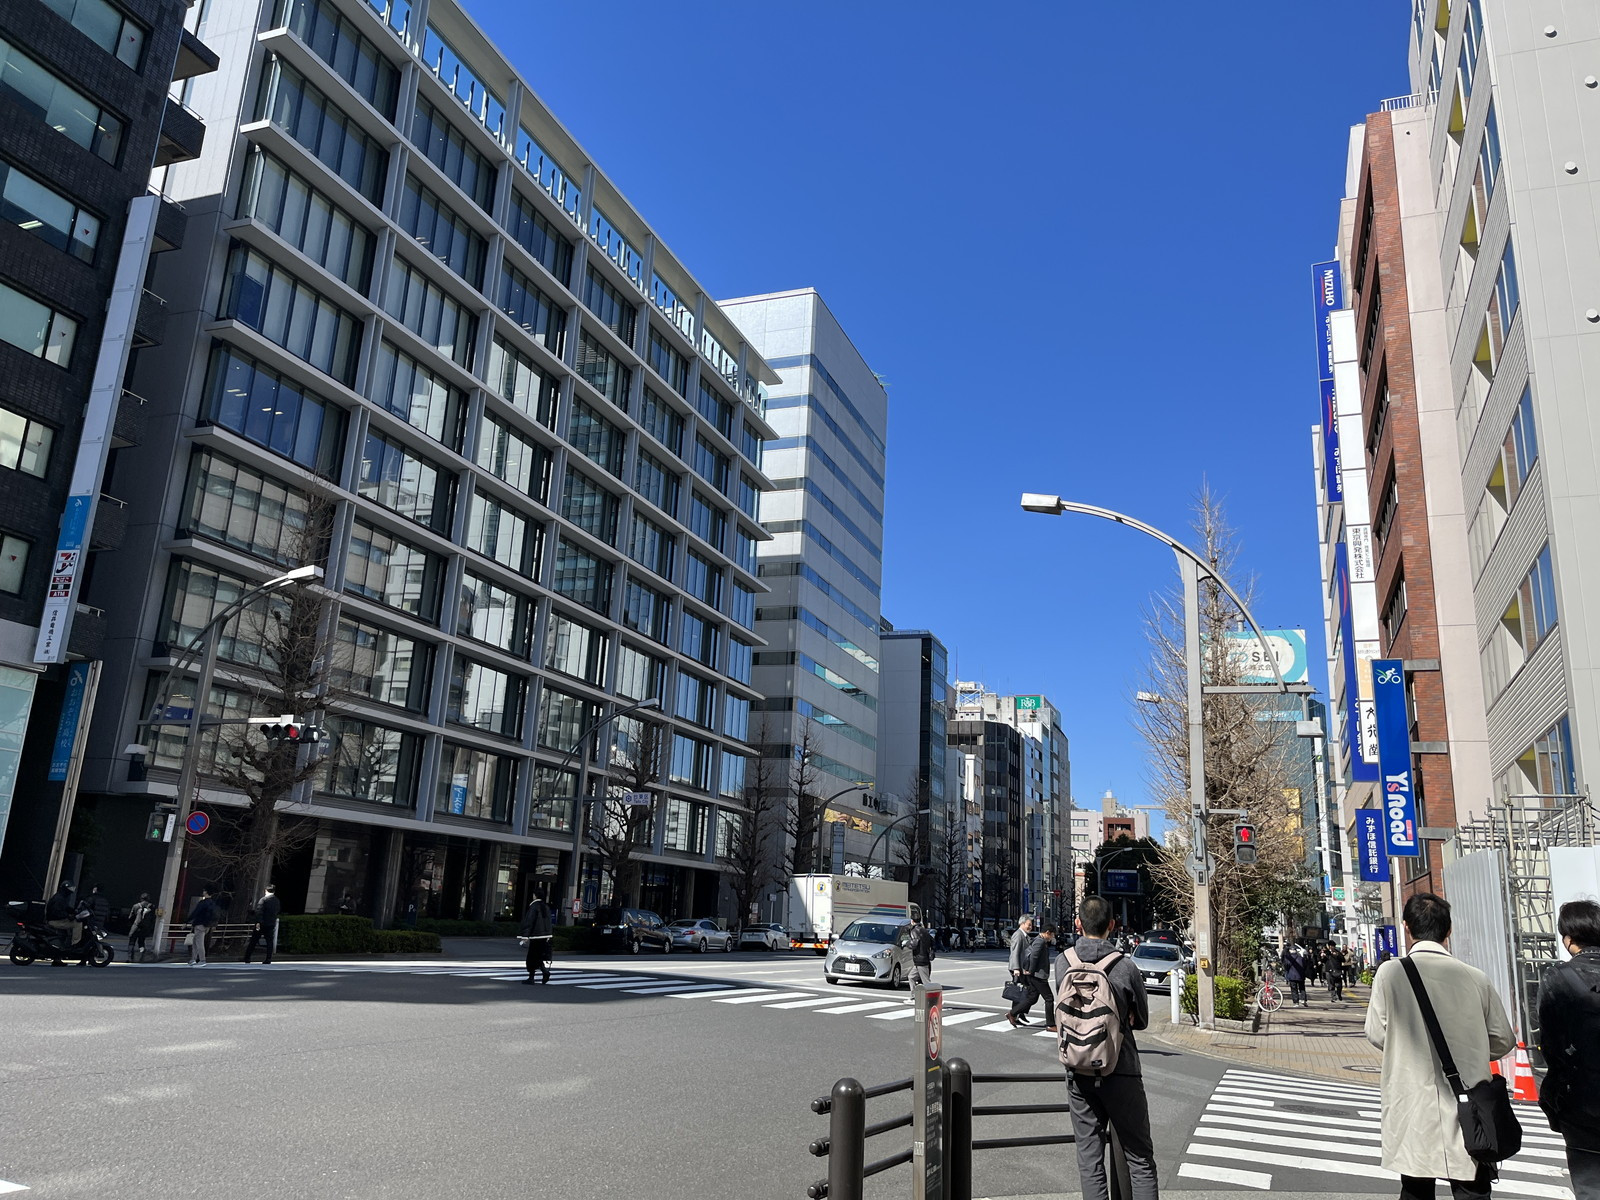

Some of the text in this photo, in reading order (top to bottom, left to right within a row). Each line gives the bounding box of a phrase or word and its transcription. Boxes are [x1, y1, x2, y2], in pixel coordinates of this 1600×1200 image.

[1324, 269, 1334, 306] MIZUHO
[1365, 816, 1379, 874] みずほ信託銀行
